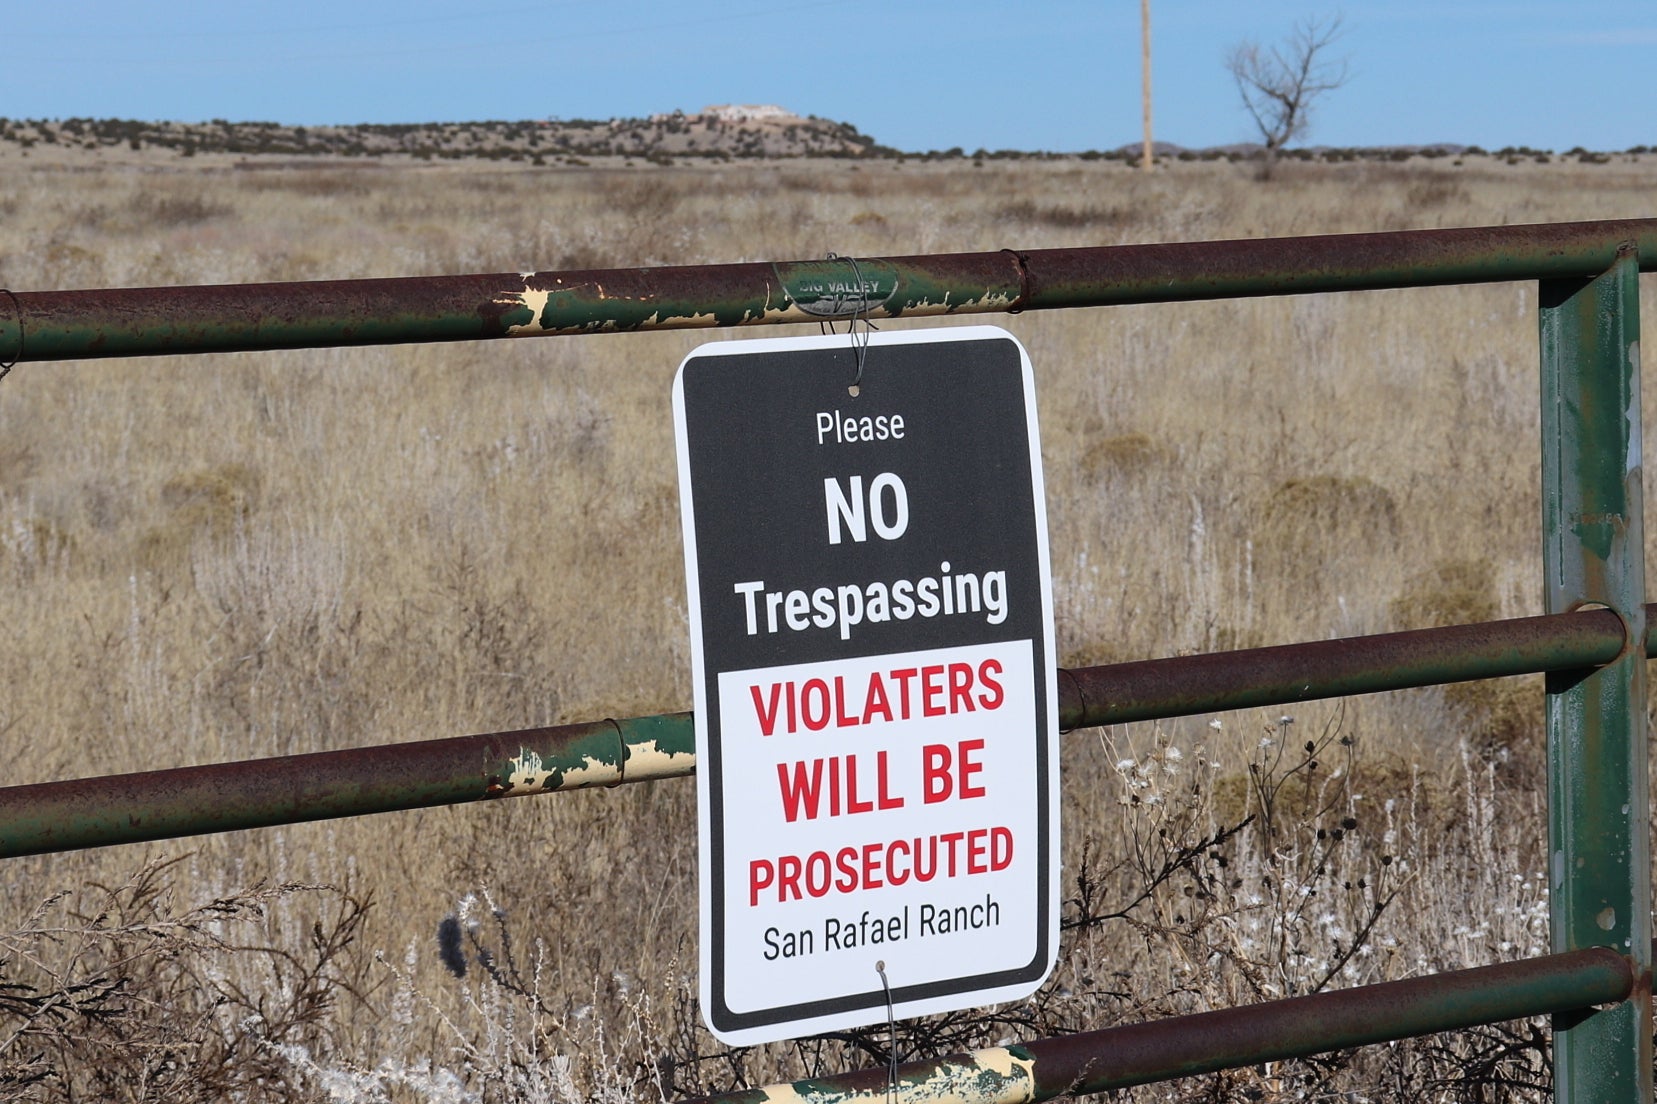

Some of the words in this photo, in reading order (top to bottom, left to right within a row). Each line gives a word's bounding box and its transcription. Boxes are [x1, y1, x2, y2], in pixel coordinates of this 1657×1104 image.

[828, 281, 879, 293] VALLEY
[816, 410, 905, 445] Please
[824, 472, 909, 545] NO
[733, 560, 1009, 641] Trespassing
[749, 658, 1005, 737] VIOLATERS
[776, 750, 905, 823] WILL
[922, 738, 987, 805] BE
[749, 826, 1014, 907] PROSECUTED
[763, 926, 813, 961] San
[825, 905, 909, 952] Rafael
[920, 893, 1000, 940] Ranch
